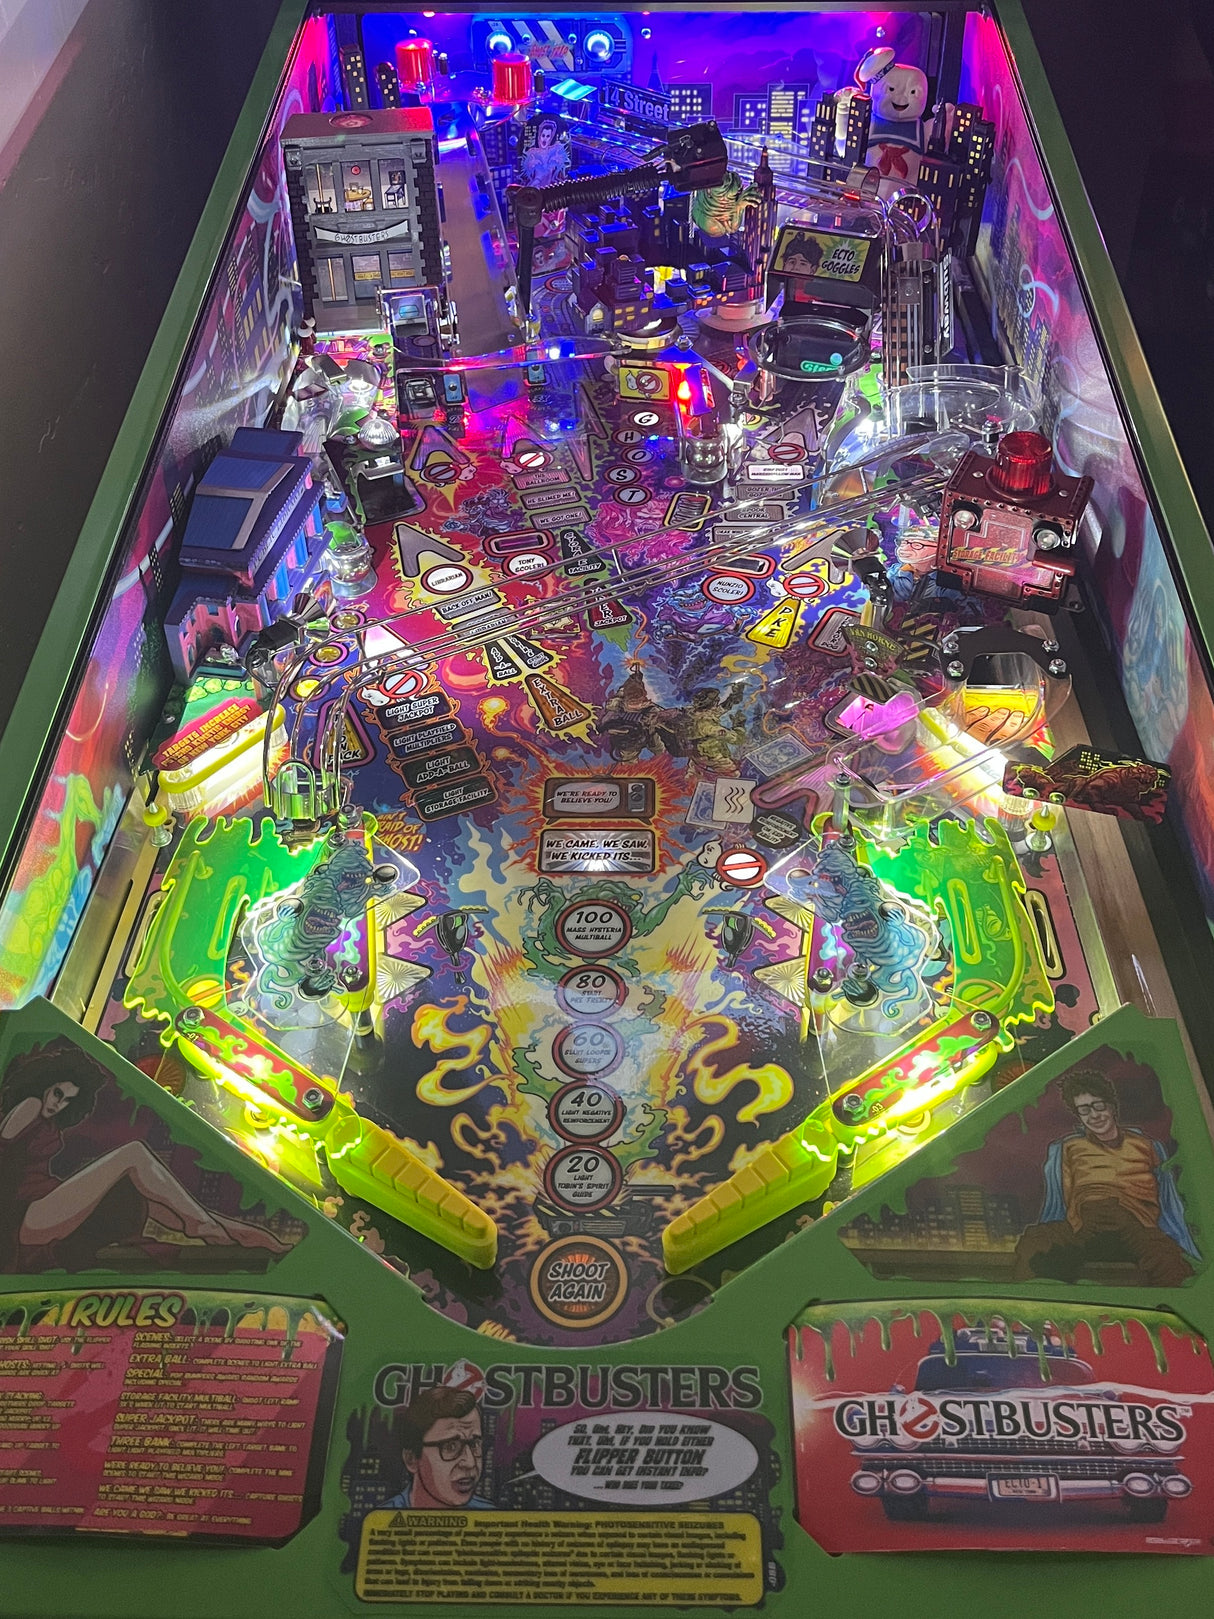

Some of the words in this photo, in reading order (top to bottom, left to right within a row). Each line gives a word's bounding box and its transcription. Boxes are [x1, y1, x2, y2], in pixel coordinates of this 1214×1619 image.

[603, 85, 620, 105] 14
[623, 91, 670, 122] Street
[832, 248, 855, 261] ECTO
[822, 260, 860, 276] GOGGLES
[639, 414, 653, 424] G
[625, 432, 634, 442] H
[632, 451, 646, 460] O
[616, 469, 627, 480] S
[526, 477, 560, 486] BALLROOM
[628, 490, 640, 501] T
[552, 515, 564, 523] GOT
[565, 512, 582, 520] ONE!
[518, 557, 535, 565] TONY
[515, 562, 545, 573] SCOLERI
[431, 572, 463, 586] LIBRARIAN
[717, 580, 744, 589] NUNZIO
[712, 584, 744, 596] SCOLERI
[442, 603, 461, 614] BACK
[461, 598, 475, 607] OFF
[476, 592, 494, 602] MAN!
[594, 615, 627, 627] JACKPOT
[849, 627, 866, 638] VAN
[866, 631, 896, 651] HORNE
[497, 668, 517, 678] BALL
[533, 679, 564, 714] EXTRA
[386, 703, 410, 717] LIGHT
[411, 696, 440, 710] SUPER
[397, 706, 434, 722] JACKPOT
[554, 710, 583, 727] BALL
[162, 730, 200, 757] TARGETS
[199, 703, 240, 732] INCREASE
[189, 742, 209, 757] NEW
[208, 727, 232, 743] YORK
[230, 714, 249, 729] CITY
[394, 734, 416, 747] LIGHT
[416, 723, 456, 740] PLAYFIELD
[405, 733, 452, 753] MULTIPLIERS
[426, 756, 450, 769] LIGHT
[446, 760, 470, 773] BALL
[443, 787, 464, 799] LIGHT
[425, 799, 457, 814] STORAGE
[458, 788, 490, 806] FACILITY
[403, 824, 423, 834] OF
[546, 839, 563, 848] WE
[565, 839, 599, 849] CAME,
[603, 839, 620, 848] WE
[621, 839, 649, 848] SAW,
[551, 851, 569, 861] WE
[570, 851, 611, 861] KICKED
[613, 851, 642, 861] ITS...
[576, 911, 613, 924] 100
[576, 975, 606, 989] 80
[573, 1031, 605, 1047] 60
[571, 1091, 603, 1107] 40
[566, 1156, 600, 1173] 20
[549, 1262, 609, 1280] SHOOT
[549, 1283, 606, 1301] AGAIN
[70, 1295, 185, 1328] RULES
[129, 1354, 161, 1363] EXTRA
[121, 1392, 156, 1400] STORAGE
[158, 1393, 192, 1401] FACILITY
[115, 1413, 147, 1422] SUPER
[615, 1424, 634, 1435] HEY,
[638, 1425, 655, 1434] DID
[658, 1425, 677, 1434] YOU
[679, 1425, 712, 1435] KNOW
[112, 1436, 142, 1445] THREE
[619, 1436, 631, 1446] IF
[633, 1436, 653, 1446] YOU
[654, 1436, 679, 1446] HOLD
[681, 1436, 715, 1446] EITHER
[574, 1448, 639, 1465] FLIPPER
[642, 1449, 706, 1465] BUTTON
[129, 1462, 157, 1470] READY
[158, 1463, 170, 1471] TO
[171, 1463, 203, 1472] BELIEVE
[570, 1465, 590, 1475] YOU
[592, 1465, 613, 1475] CAN
[615, 1466, 634, 1475] GET
[635, 1466, 677, 1476] INSTANT
[679, 1466, 708, 1476] INFO?
[189, 1488, 218, 1497] KICKED
[407, 1515, 467, 1528] WARNING
[474, 1520, 518, 1529] Important
[520, 1520, 551, 1528] Health
[553, 1521, 593, 1530] Warning:
[595, 1521, 676, 1529] PHOTOSENSITIVE
[677, 1521, 724, 1529] SEIZURES
[415, 1590, 435, 1598] STOP
[437, 1590, 469, 1599] PLAYING
[471, 1590, 488, 1598] AND
[489, 1591, 524, 1599] CONSULT
[533, 1591, 564, 1600] DOCTOR
[575, 1592, 591, 1600] YOU
[592, 1592, 639, 1600] EXPERIENCE
